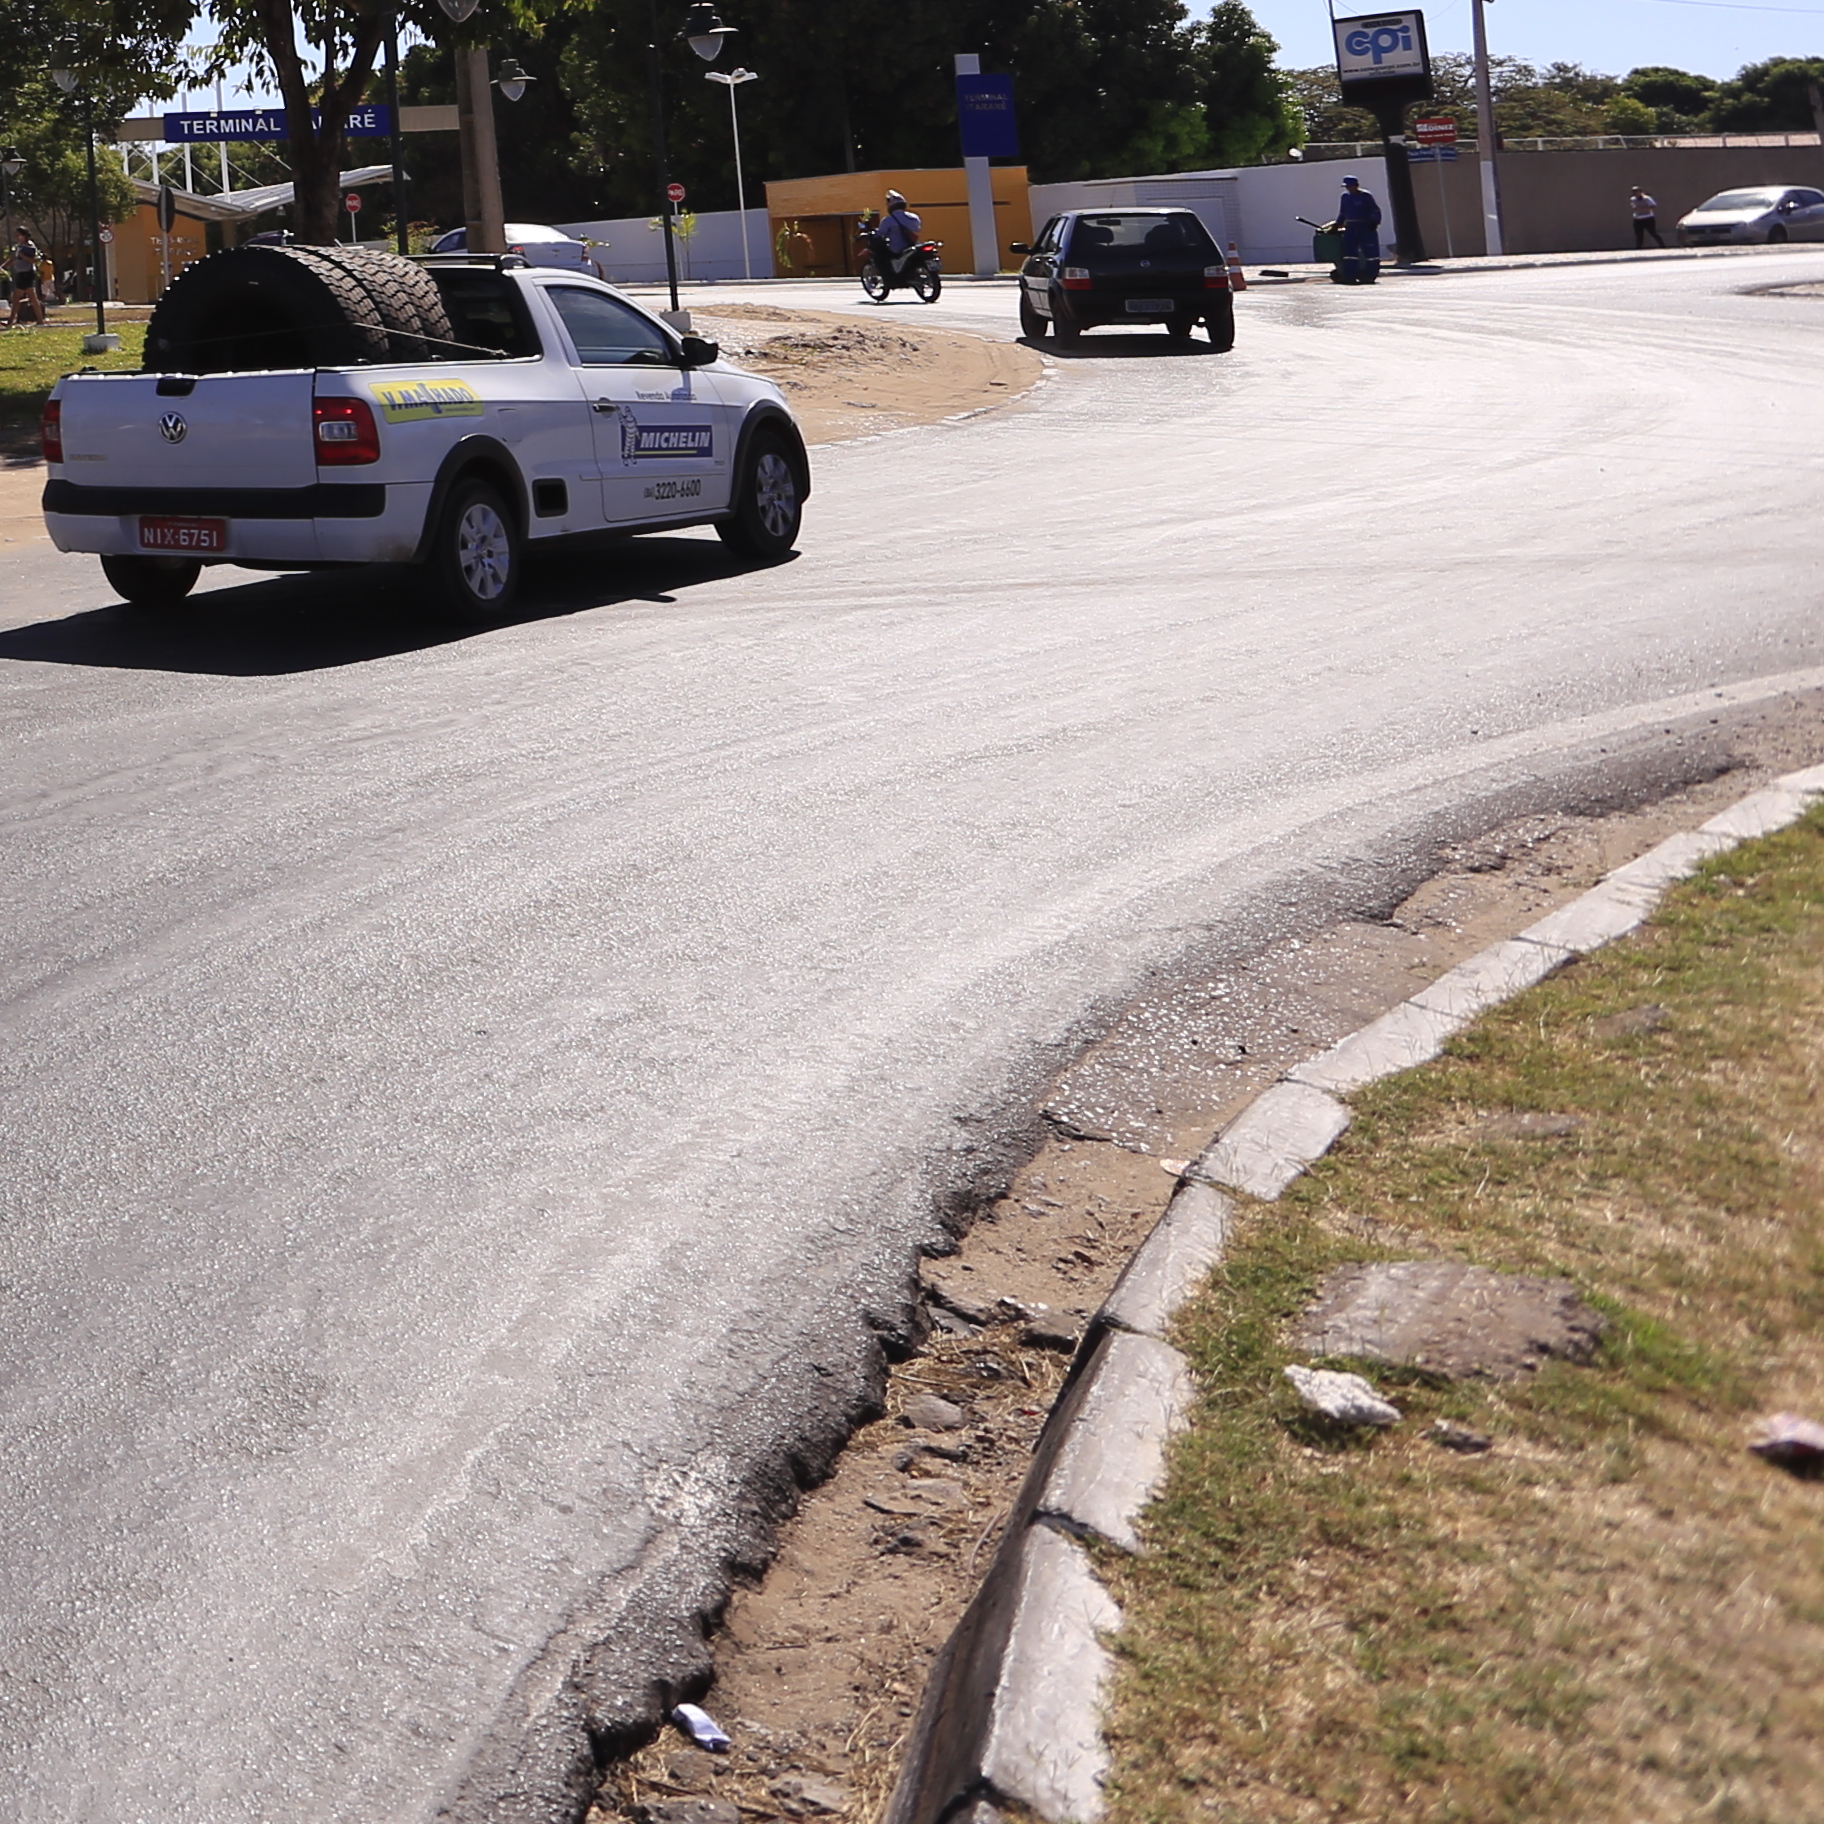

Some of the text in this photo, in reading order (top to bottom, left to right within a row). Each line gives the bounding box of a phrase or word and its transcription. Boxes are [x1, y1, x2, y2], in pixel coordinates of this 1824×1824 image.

[1345, 24, 1412, 65] cpi
[180, 118, 282, 135] TERMINAL
[640, 432, 711, 449] MICHELIN
[655, 478, 701, 500] 3220-6600
